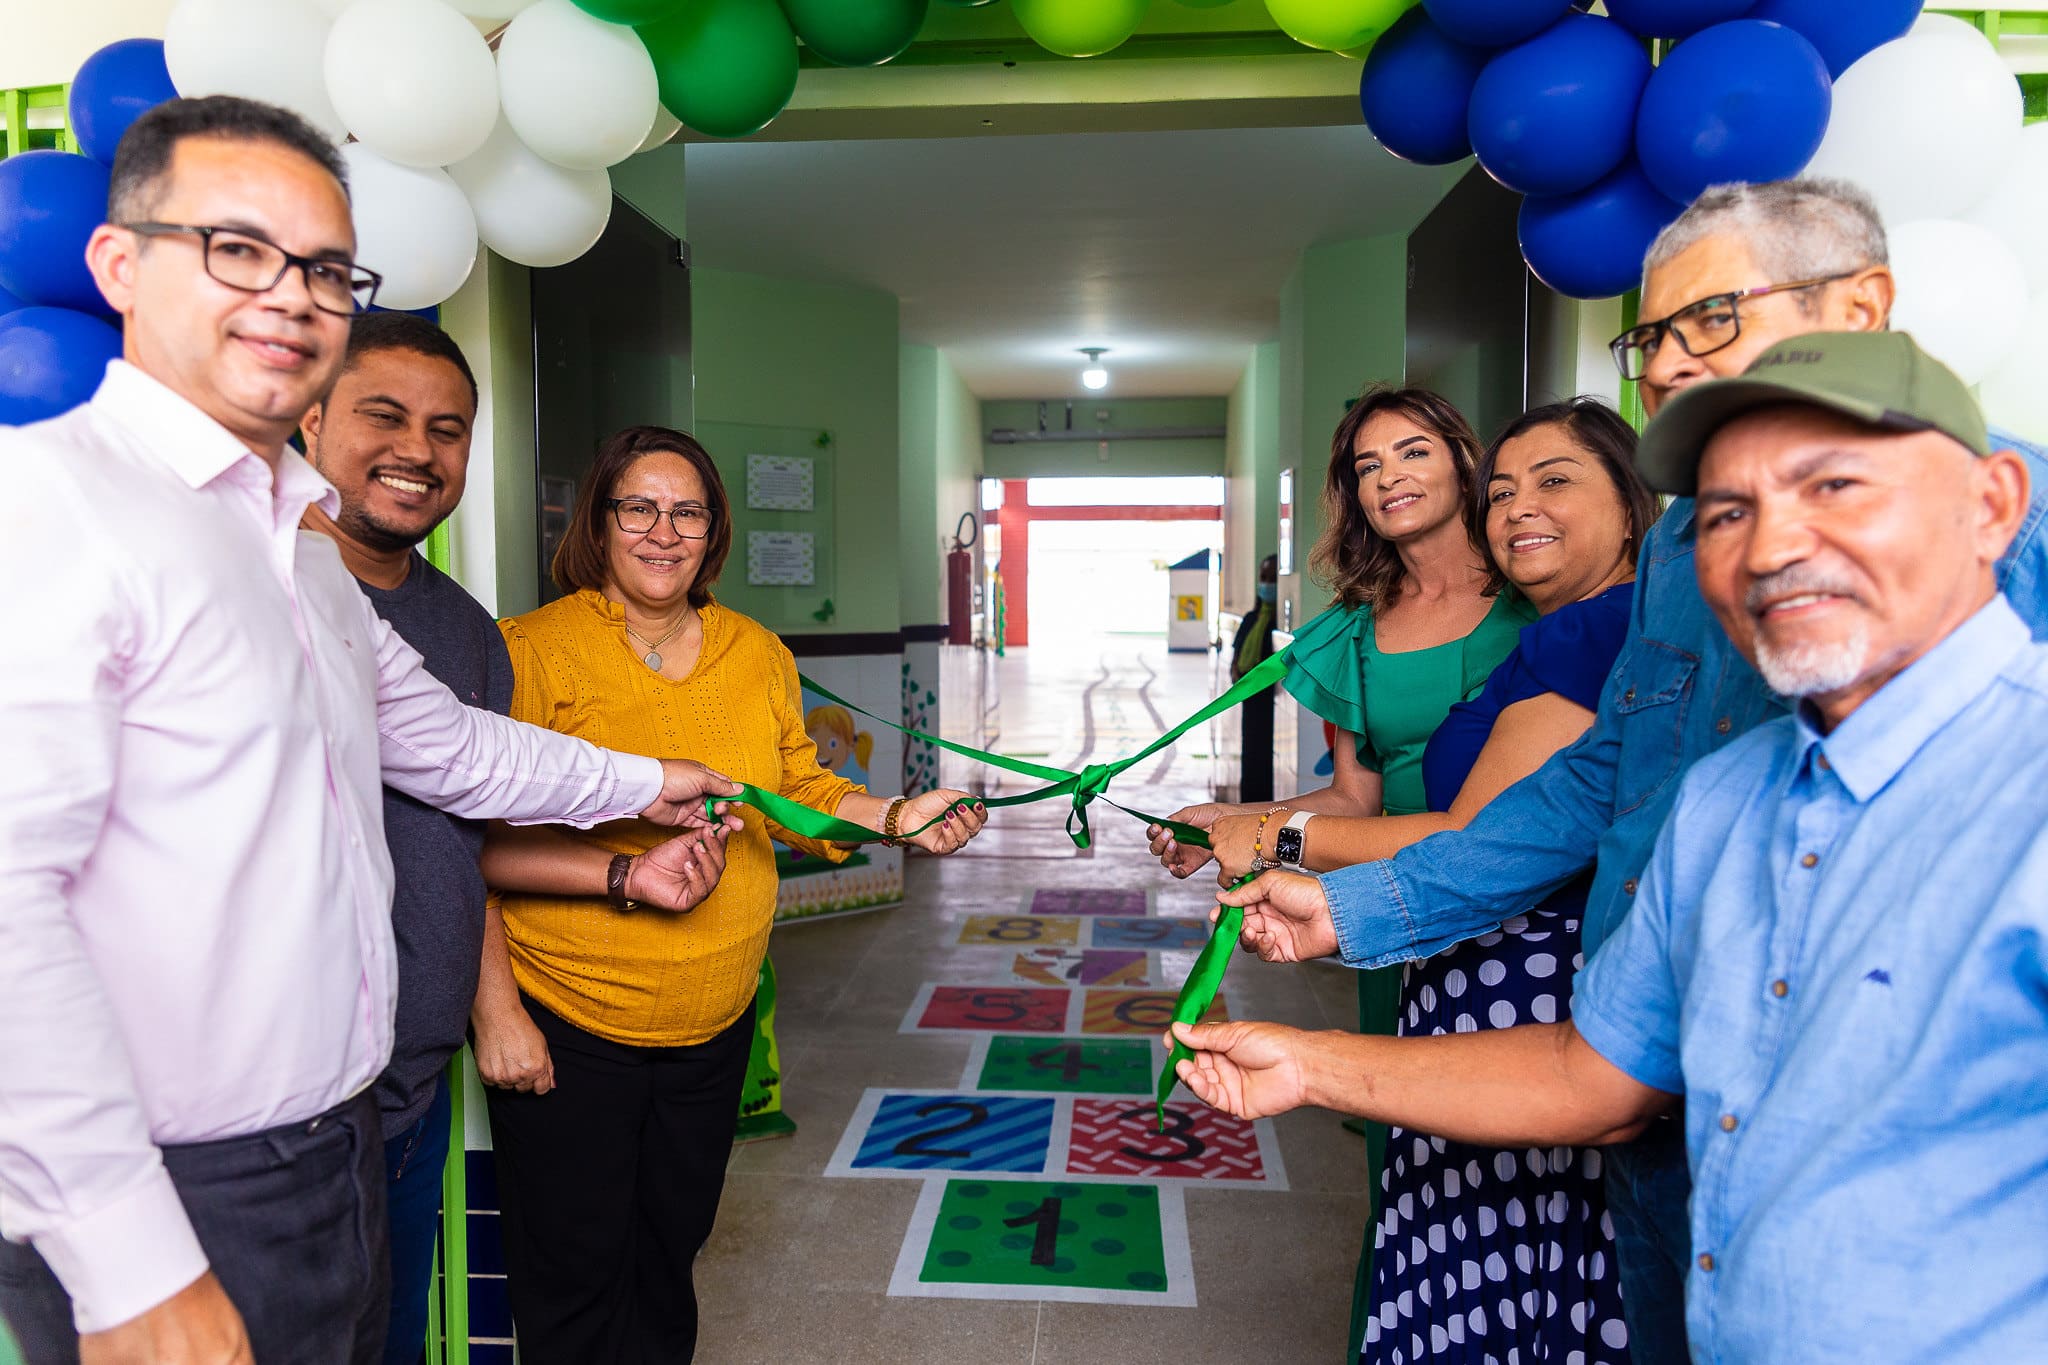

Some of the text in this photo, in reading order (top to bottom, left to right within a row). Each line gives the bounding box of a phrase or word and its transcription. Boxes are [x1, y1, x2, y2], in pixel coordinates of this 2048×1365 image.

[987, 918, 1044, 941] 8
[1119, 919, 1173, 942] 9
[964, 994, 1028, 1023] 5
[1114, 996, 1178, 1027] 6
[1027, 1042, 1099, 1081] 4
[894, 1102, 988, 1158] 2
[1116, 1107, 1206, 1162] 3
[1002, 1197, 1062, 1266] 1
